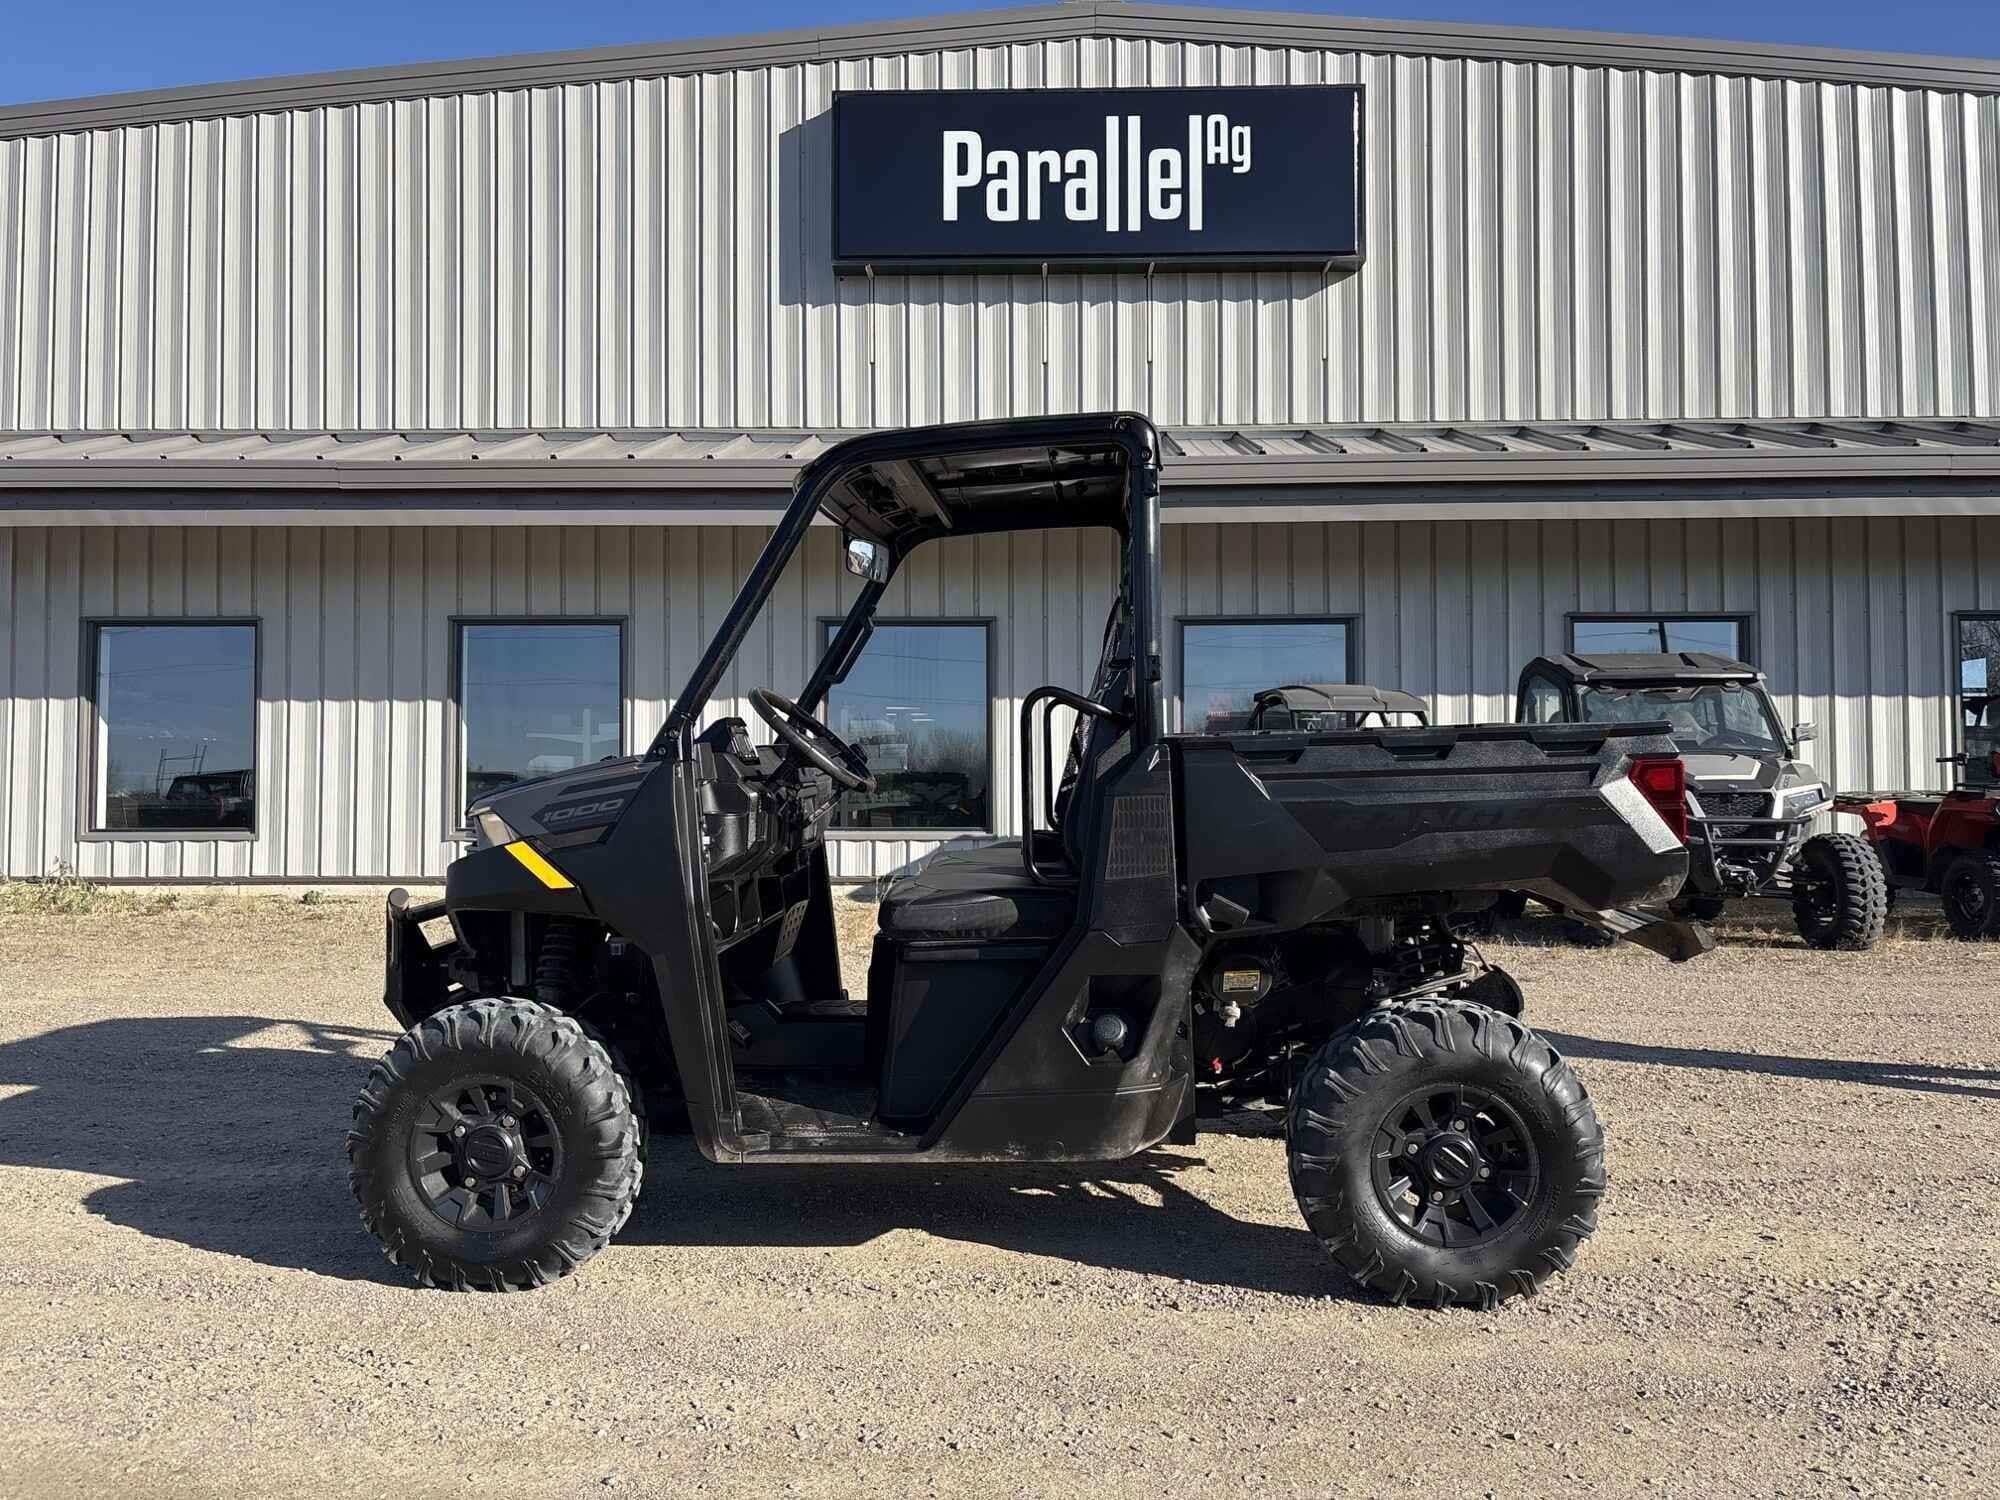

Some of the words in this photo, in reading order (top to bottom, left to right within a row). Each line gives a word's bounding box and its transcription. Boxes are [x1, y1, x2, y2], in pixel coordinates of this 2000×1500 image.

[942, 115, 1203, 231] Parallel
[1206, 114, 1252, 174] Ag
[543, 798, 625, 823] 1000
